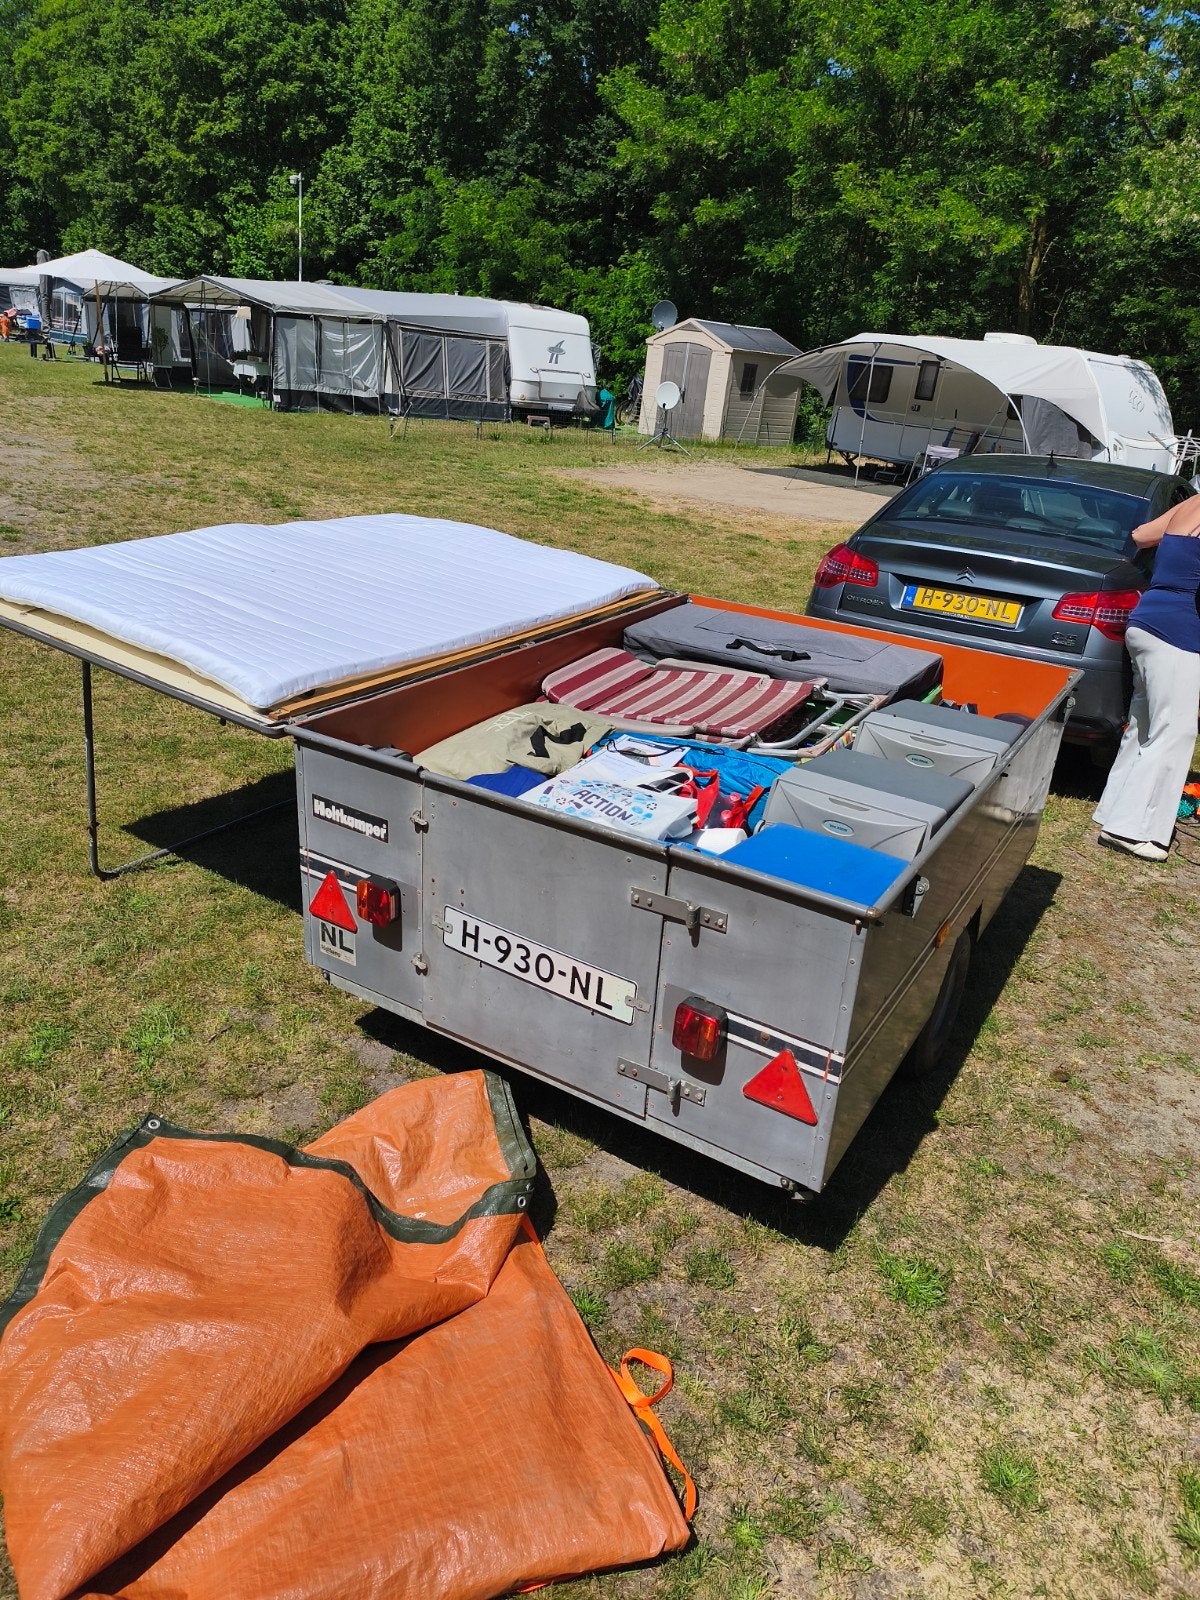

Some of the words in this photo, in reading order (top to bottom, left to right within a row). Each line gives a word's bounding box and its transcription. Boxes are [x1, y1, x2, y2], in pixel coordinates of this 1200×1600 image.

[920, 585, 1011, 620] H-930-NL
[313, 798, 387, 839] Holtkamper
[572, 789, 634, 821] ACTION
[320, 921, 354, 955] NL
[461, 919, 613, 1011] H-930-NL
